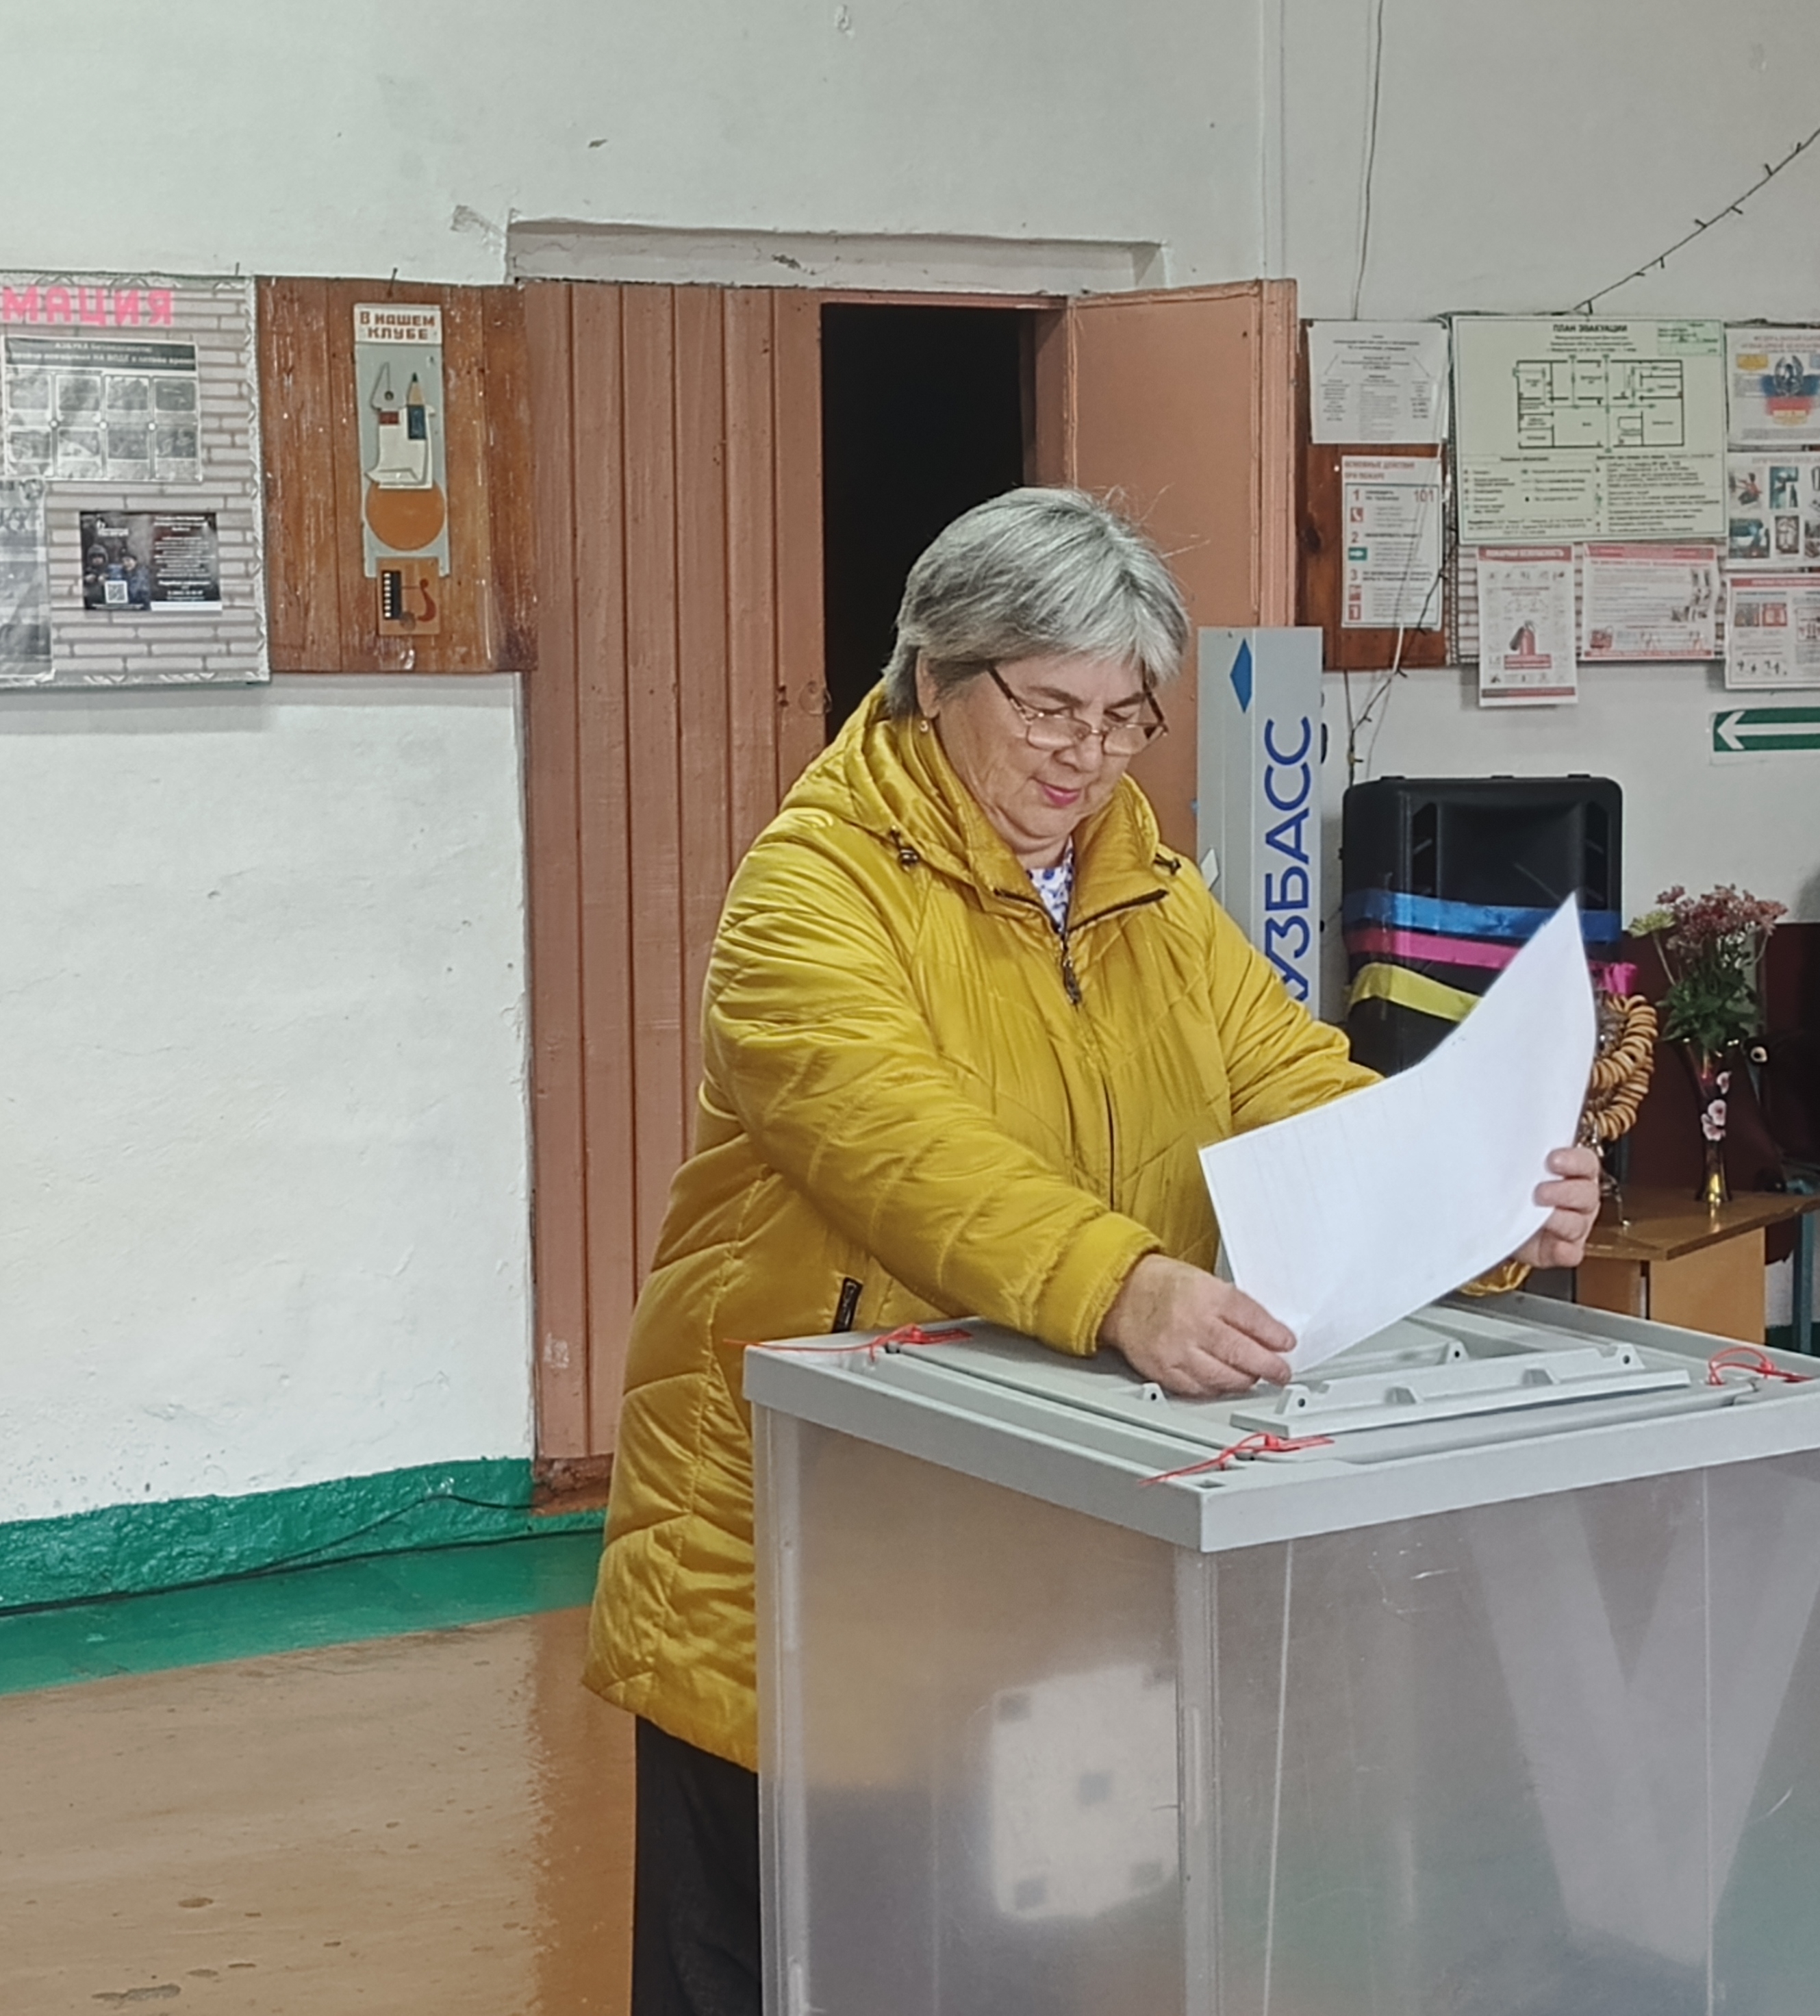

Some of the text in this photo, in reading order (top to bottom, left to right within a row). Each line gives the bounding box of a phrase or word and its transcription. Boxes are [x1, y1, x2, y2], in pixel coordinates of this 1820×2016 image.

[2, 285, 173, 327] МАЦИЯ
[359, 310, 370, 325] В
[368, 327, 429, 340] КЛУБЕ
[1552, 324, 1628, 333] ПЛАН ЭВАКУАЦИИ
[1352, 489, 1360, 501] 1
[1414, 489, 1434, 502] 101
[1351, 532, 1359, 543] 2
[1350, 569, 1358, 581] 3
[1264, 716, 1311, 1002] УЗБАСС
